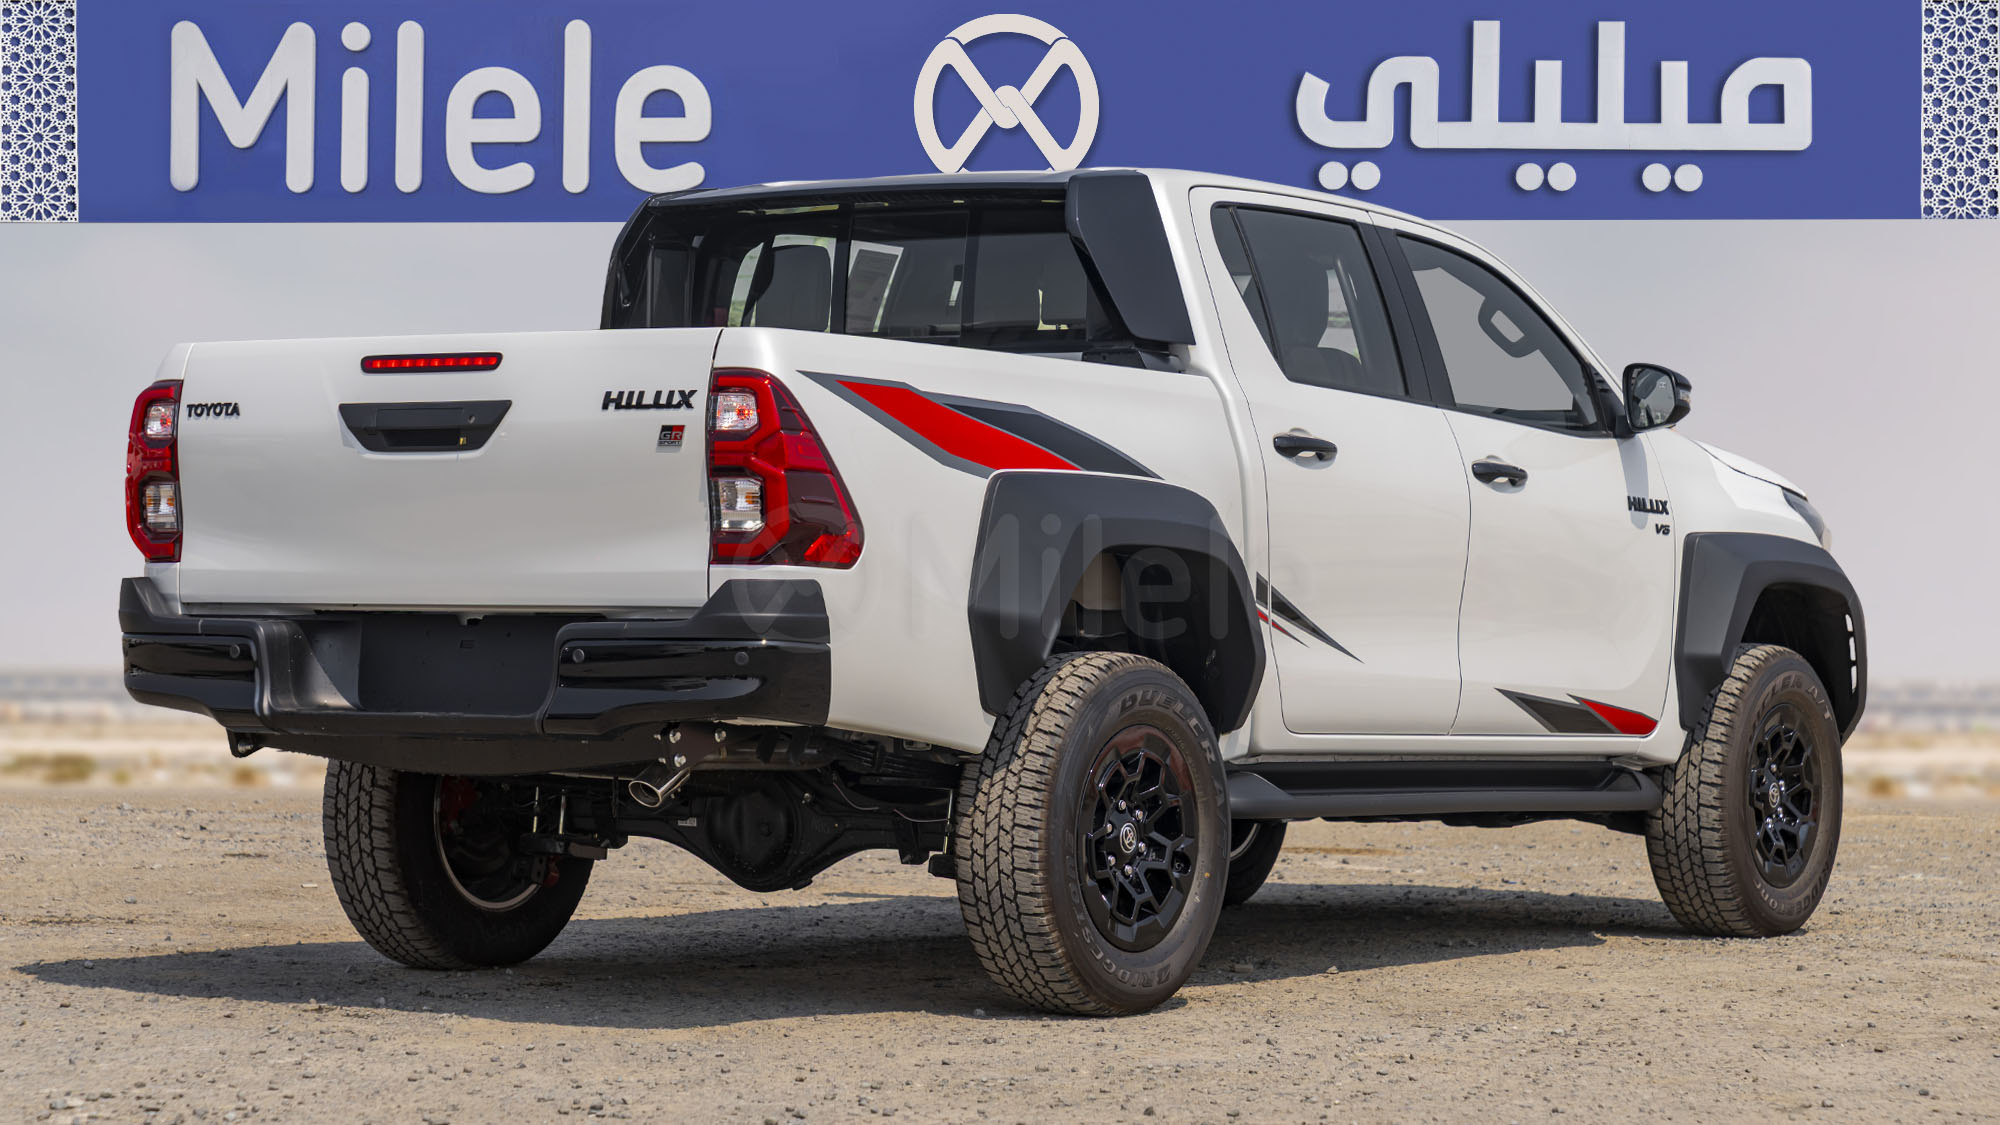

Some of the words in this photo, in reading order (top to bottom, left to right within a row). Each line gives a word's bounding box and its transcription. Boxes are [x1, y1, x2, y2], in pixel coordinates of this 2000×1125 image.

[170, 18, 713, 194] Milele
[1296, 20, 1813, 192] ميليلي
[186, 402, 240, 418] TOYOTA
[601, 390, 697, 410] HILUX
[660, 431, 682, 440] GR
[1627, 495, 1669, 515] HILUX
[1655, 523, 1670, 535] V6
